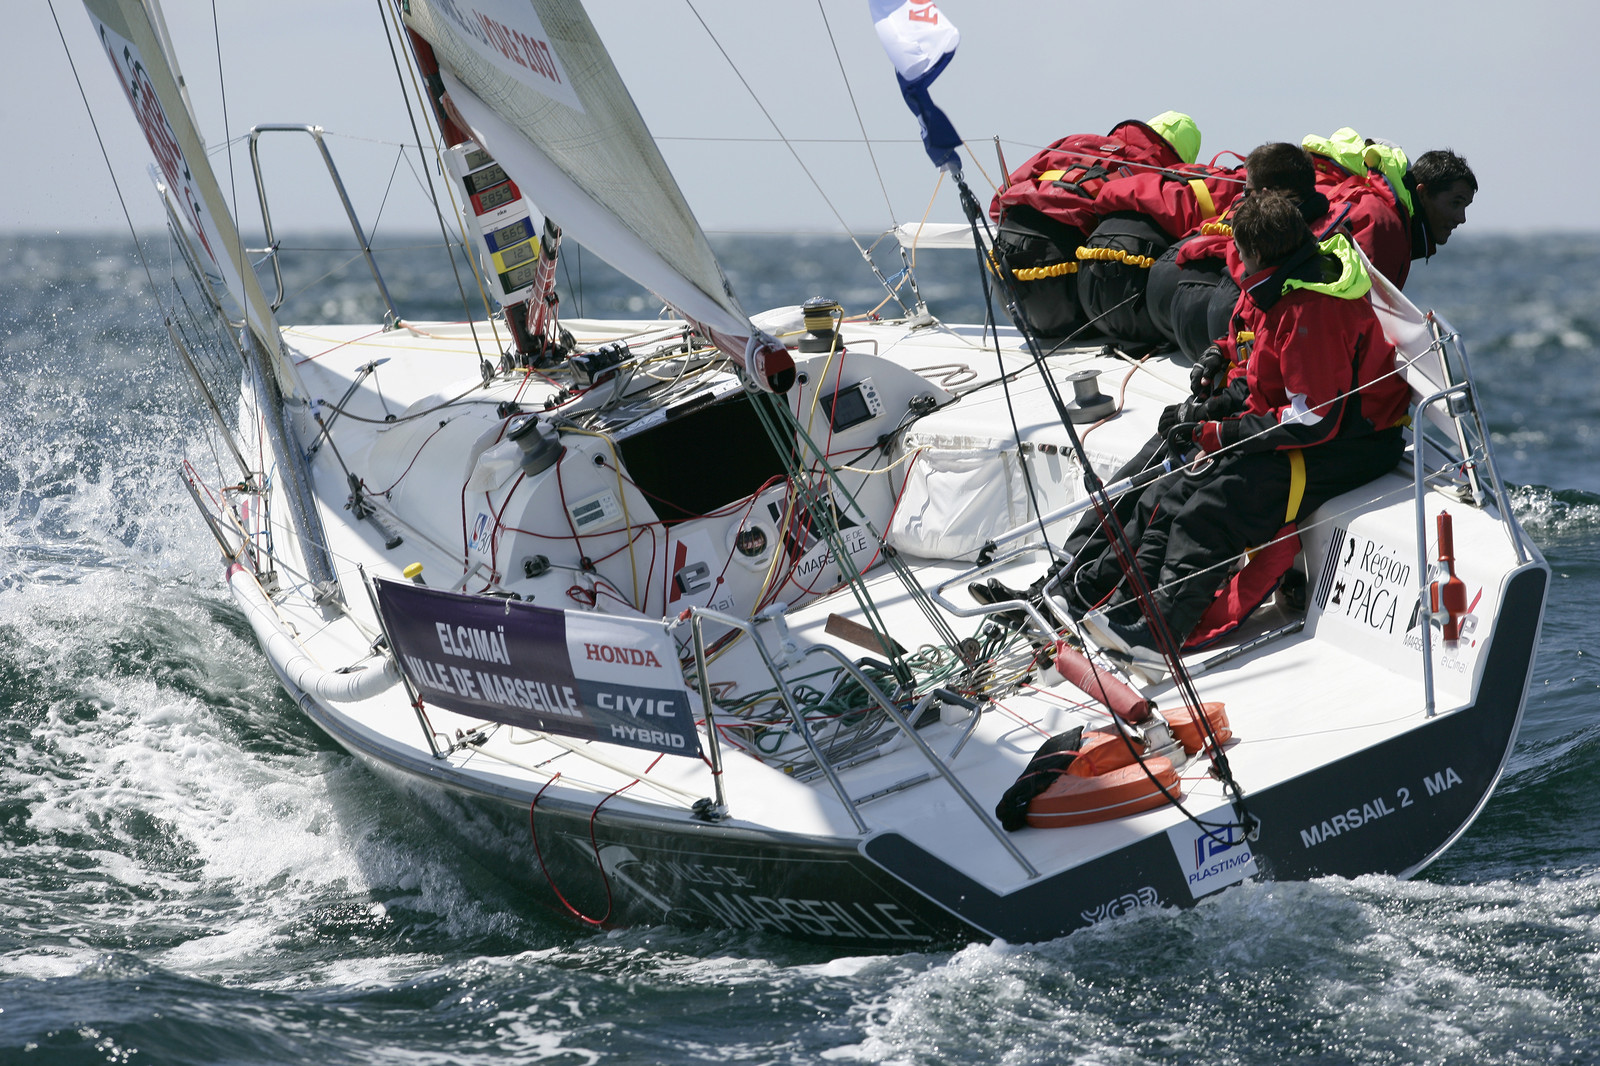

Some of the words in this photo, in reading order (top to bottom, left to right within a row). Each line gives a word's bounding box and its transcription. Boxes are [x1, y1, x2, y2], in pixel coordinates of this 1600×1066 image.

[1360, 540, 1410, 588] Région
[1346, 579, 1399, 635] PACA
[435, 622, 511, 666] ELCIMAÏ
[584, 643, 662, 668] HONDA
[403, 654, 455, 694] VILLE
[452, 668, 482, 701] DE
[478, 673, 583, 718] MARSEILLE
[597, 693, 676, 718] CIVIC
[611, 724, 685, 749] HYBRID
[1300, 797, 1395, 849] MARSAIL
[1397, 787, 1413, 808] 2
[1423, 767, 1462, 797] MA
[712, 866, 756, 888] DE
[1189, 852, 1251, 885] PLASTIMO
[690, 888, 932, 941] MARSEILLE
